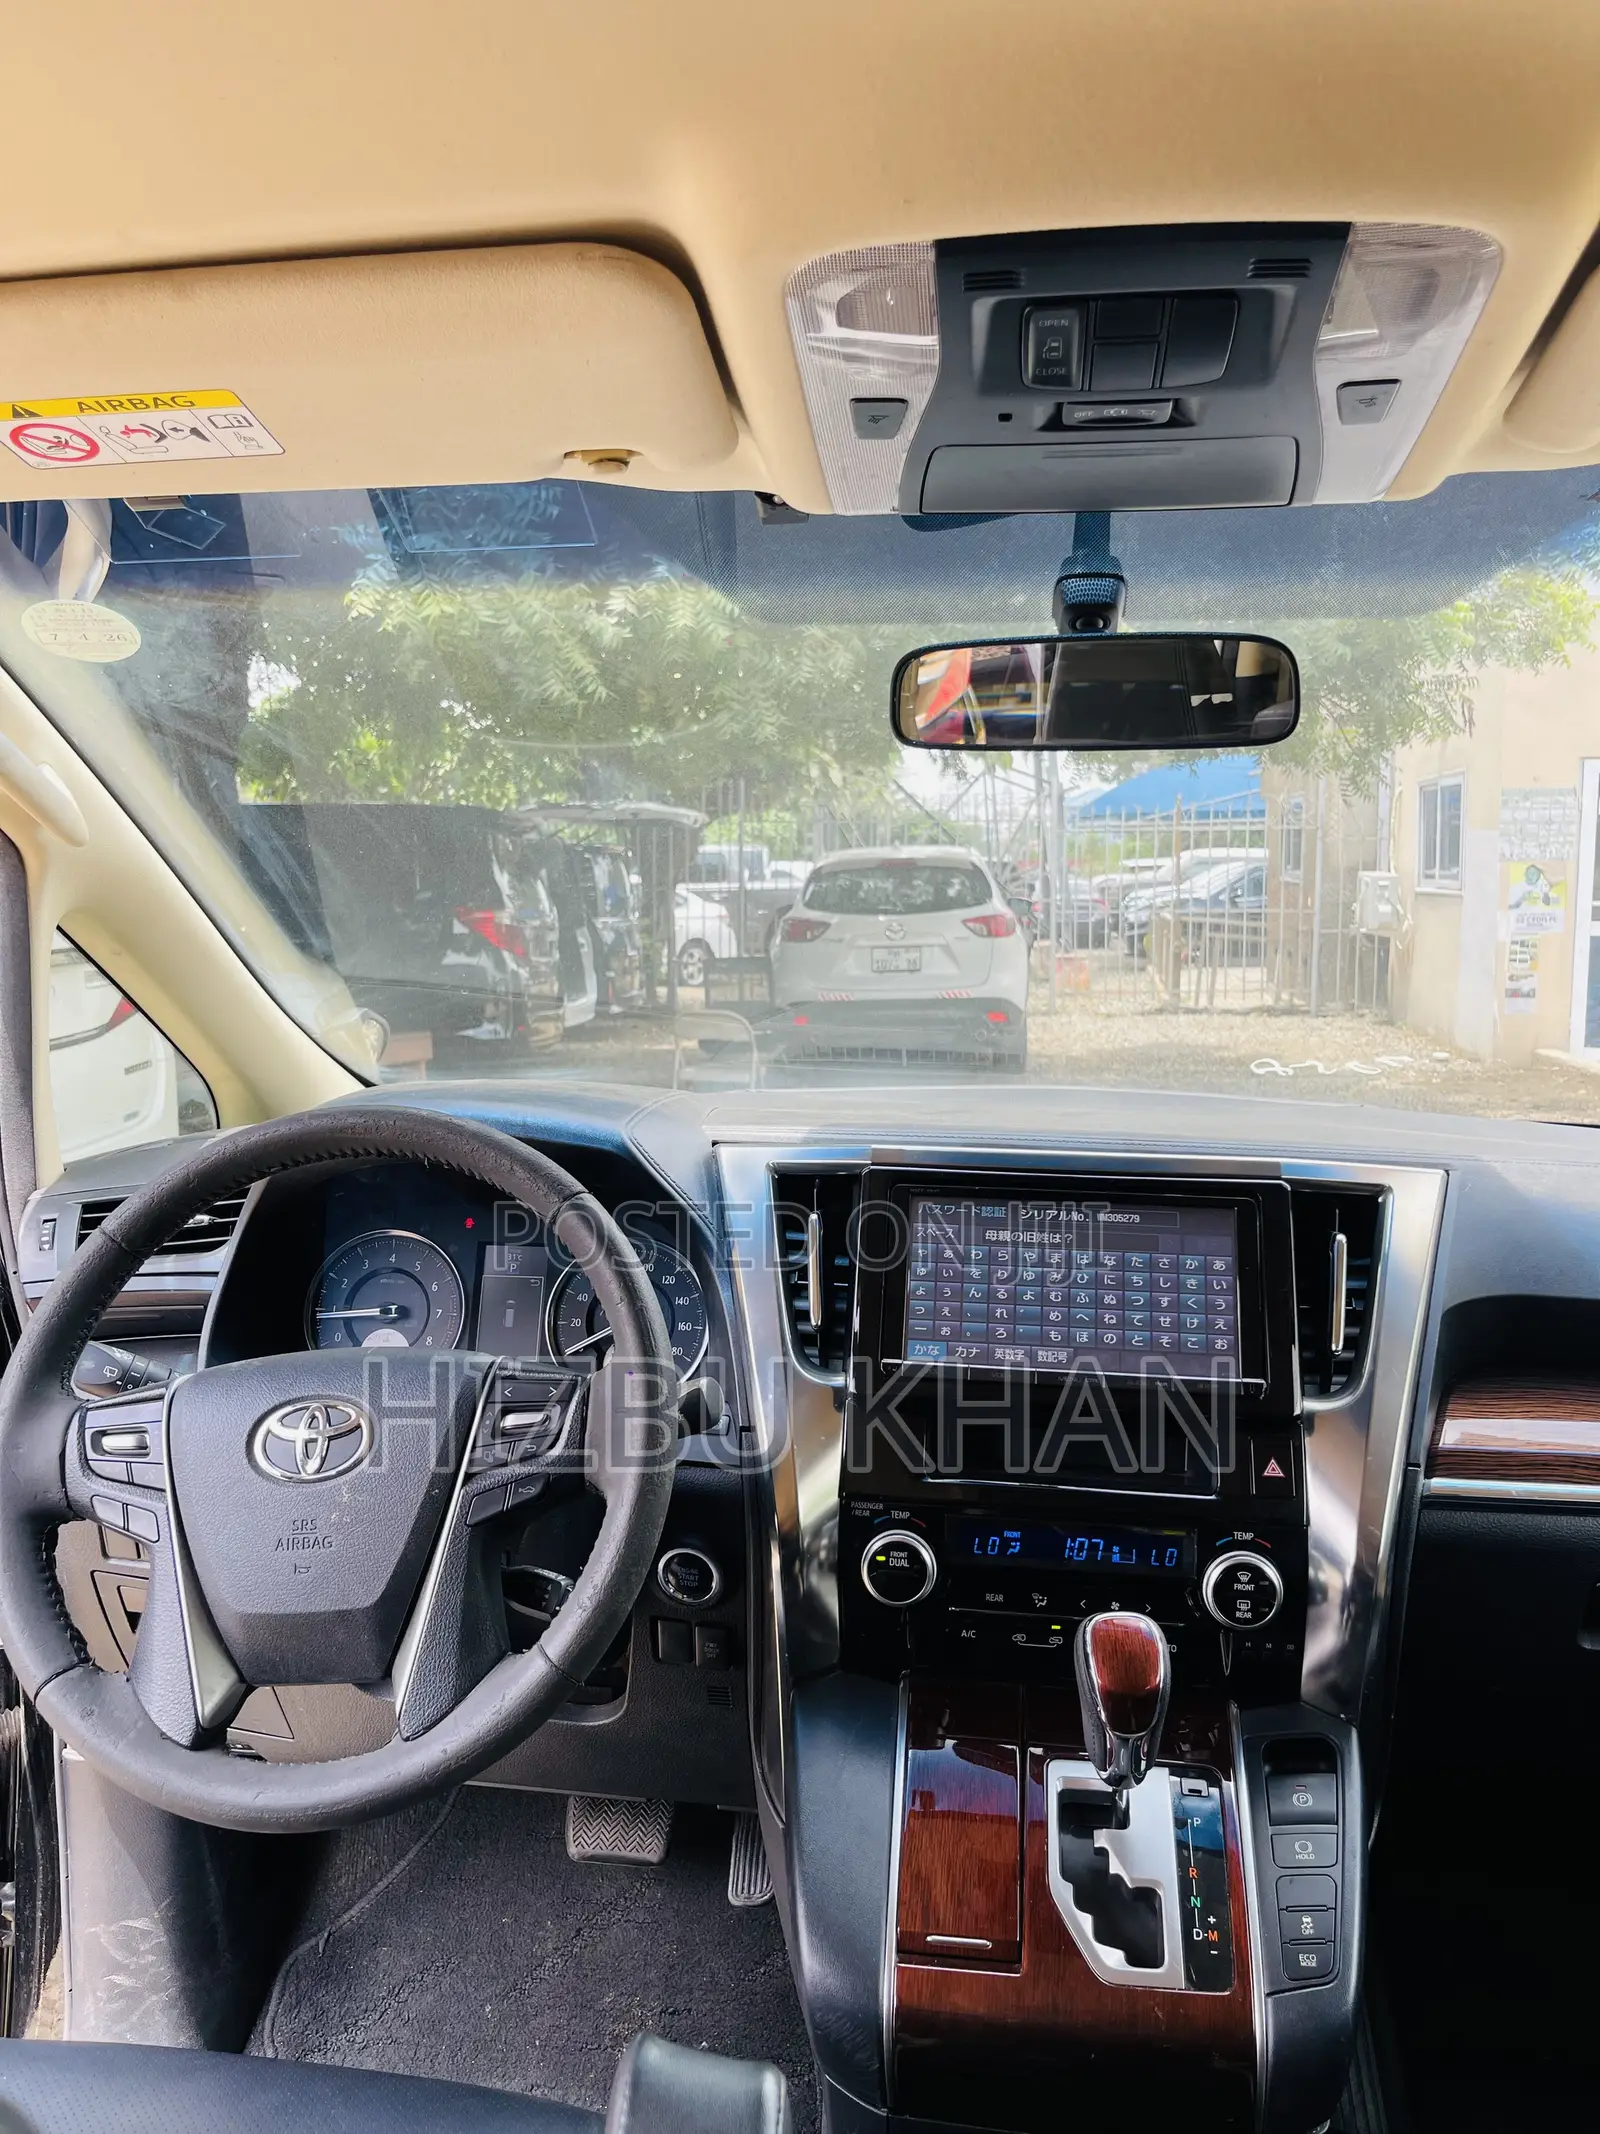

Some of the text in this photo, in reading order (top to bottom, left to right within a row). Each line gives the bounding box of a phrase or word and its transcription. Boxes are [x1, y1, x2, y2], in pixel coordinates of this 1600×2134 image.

[1038, 319, 1068, 327] OPEN
[77, 395, 196, 414] AIRBAG
[918, 1204, 1006, 1218] パスワード認証
[916, 1228, 954, 1238] スペース
[389, 1253, 396, 1263] 4
[970, 1250, 982, 1260] わ
[998, 1250, 1008, 1261] ら
[1023, 1252, 1036, 1262] や
[1050, 1252, 1062, 1263] ま
[1077, 1254, 1089, 1264] は
[1104, 1255, 1117, 1266] な
[1131, 1256, 1144, 1267] た
[1158, 1257, 1171, 1268] さ
[1185, 1258, 1198, 1270] か
[1212, 1260, 1226, 1271] あ
[363, 1259, 369, 1269] 3
[415, 1261, 421, 1271] 5
[510, 1263, 517, 1272] P
[341, 1278, 348, 1288] 2
[662, 1276, 675, 1284] 120
[969, 1268, 982, 1279] を
[997, 1269, 1008, 1280] り
[1023, 1270, 1035, 1281] ゆ
[1049, 1271, 1062, 1281] み
[1076, 1273, 1089, 1284] ひ
[1104, 1274, 1116, 1285] に
[1132, 1276, 1143, 1286] ち
[1159, 1277, 1171, 1287] し
[1185, 1278, 1198, 1289] き
[1213, 1280, 1226, 1290] い
[432, 1281, 438, 1292] 6
[576, 1293, 588, 1302] 40
[675, 1297, 689, 1305] 140
[969, 1287, 982, 1298] ん
[997, 1289, 1008, 1299] る
[1023, 1290, 1035, 1300] よ
[1049, 1291, 1061, 1302] む
[1076, 1293, 1089, 1303] ふ
[1104, 1294, 1117, 1305] ぬ
[1131, 1296, 1144, 1306] つ
[1159, 1296, 1171, 1308] す
[1187, 1297, 1197, 1309] く
[1214, 1299, 1226, 1310] う
[436, 1309, 442, 1319] 7
[995, 1308, 1008, 1318] れ
[1049, 1311, 1061, 1322] め
[1076, 1313, 1089, 1321] へ
[1103, 1313, 1117, 1324] ね
[1131, 1315, 1144, 1326] て
[1159, 1316, 1171, 1327] せ
[1186, 1317, 1199, 1328] け
[1214, 1319, 1228, 1330] え
[678, 1322, 692, 1331] 160
[334, 1332, 341, 1342] 0
[426, 1336, 432, 1346] 8
[995, 1327, 1007, 1338] ろ
[1049, 1330, 1061, 1341] も
[1076, 1332, 1089, 1343] ほ
[1104, 1333, 1116, 1344] の
[1132, 1335, 1144, 1345] と
[1159, 1336, 1171, 1347] そ
[1188, 1338, 1199, 1348] こ
[1214, 1339, 1228, 1350] お
[672, 1347, 682, 1355] 80
[914, 1344, 939, 1355] かな
[955, 1346, 980, 1357] カナ
[994, 1348, 1025, 1360] 英数字
[1037, 1350, 1068, 1363] 数記号
[850, 1501, 883, 1510] PASSENGER
[891, 1510, 910, 1519] TEMP
[292, 1519, 317, 1532] SRS
[1004, 1530, 1021, 1539] FRONT
[1233, 1532, 1254, 1540] TEMP
[275, 1536, 333, 1551] AIRBAG
[1064, 1538, 1103, 1560] 1:07
[889, 1558, 910, 1567] DUAL
[986, 1593, 1004, 1602] REAR
[961, 1630, 976, 1638] A/C
[1193, 1817, 1200, 1828] P
[1189, 1867, 1198, 1879] R
[1190, 1896, 1200, 1908] N
[1299, 1954, 1316, 1962] ECO
